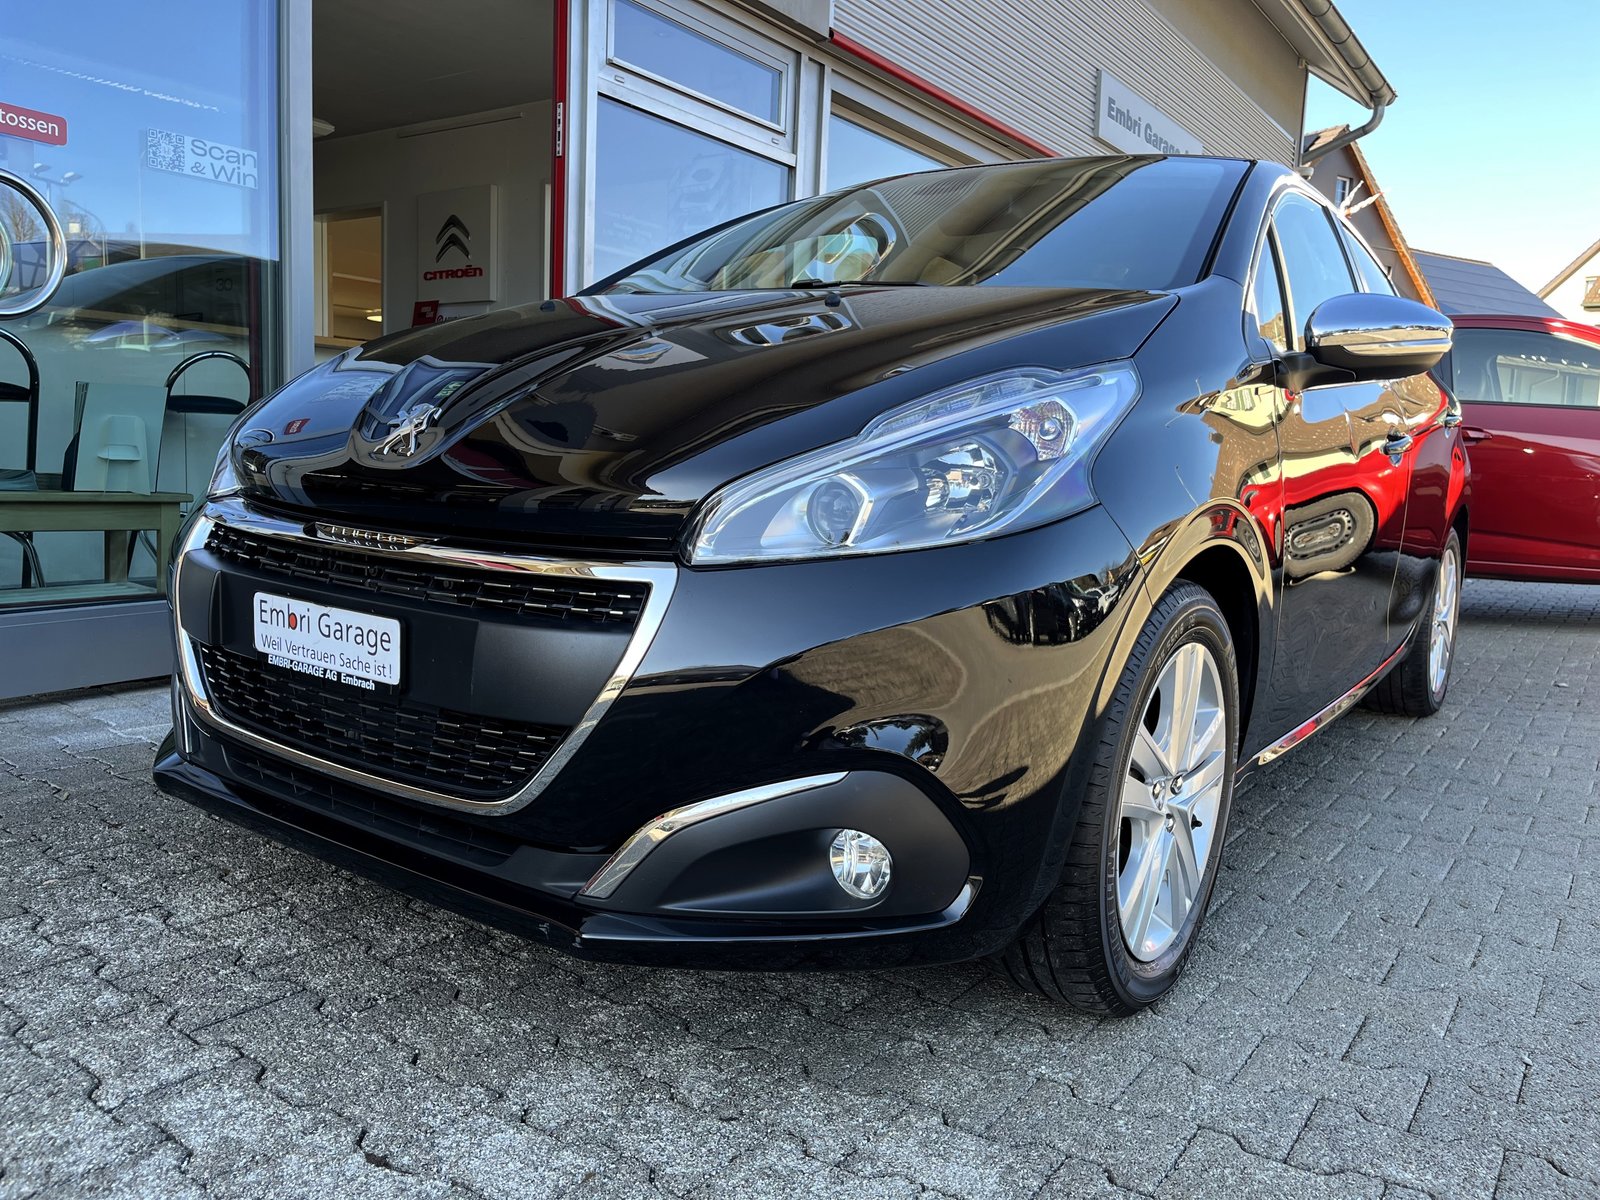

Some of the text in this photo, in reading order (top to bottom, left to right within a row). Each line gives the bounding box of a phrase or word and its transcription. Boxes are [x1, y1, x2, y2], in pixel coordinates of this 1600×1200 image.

[1107, 96, 1142, 138] Embri
[190, 139, 257, 169] Scan
[190, 161, 257, 188] & Win
[331, 526, 409, 545] PEUGEOT
[259, 599, 391, 656] Embri Garage
[261, 633, 283, 651] Weil
[284, 639, 337, 666] Vertrauen
[339, 653, 372, 675] Sache
[267, 654, 376, 692] EMBRI-GARAGE AG Embrach
